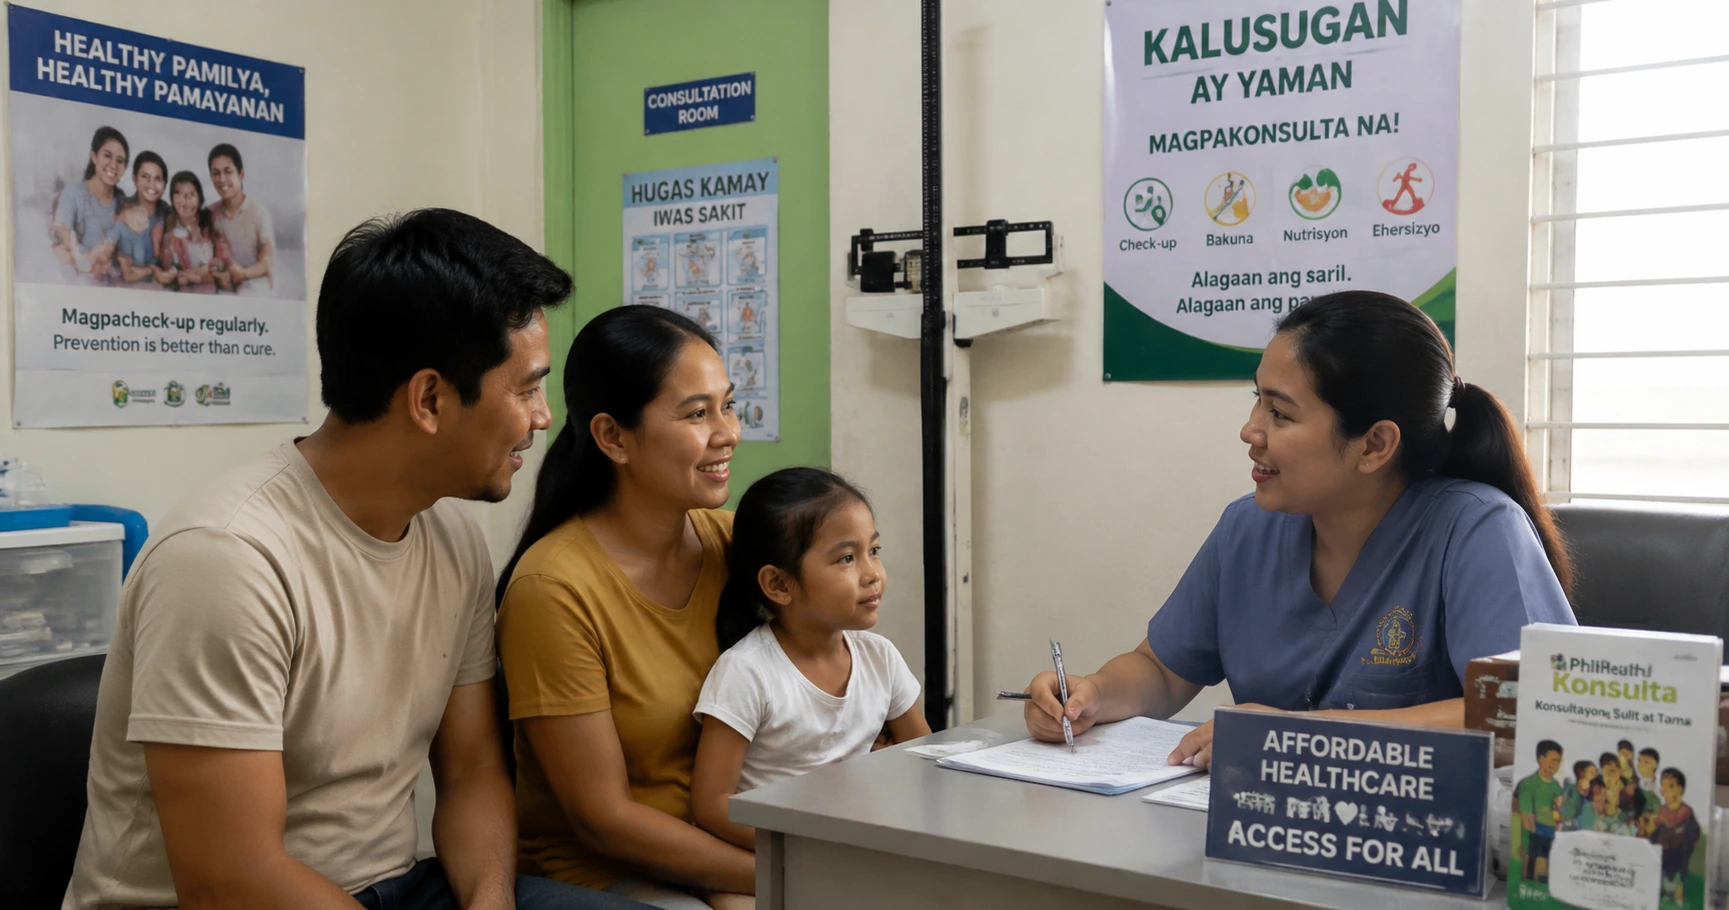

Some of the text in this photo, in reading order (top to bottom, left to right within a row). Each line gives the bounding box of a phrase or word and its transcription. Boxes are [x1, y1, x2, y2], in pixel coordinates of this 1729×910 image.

[1144, 0, 1407, 66] KALUSUGAN
[55, 30, 269, 97] HEALTHY PAMILYA,
[38, 57, 283, 123] HEALTHY PAMAYANAN
[648, 80, 751, 108] CONSULTATION
[1191, 60, 1352, 104] AY YAMAN
[679, 105, 718, 123] ROOM
[1150, 113, 1399, 154] MAGPAKONSULTA NA!
[632, 172, 769, 203] HUGAS KAMAY
[654, 203, 746, 226] IWAS SAKIT
[1207, 234, 1253, 246] Bakuna
[1284, 228, 1347, 242] Nutrisyon
[1373, 222, 1440, 237] Ehersizyo
[1120, 237, 1177, 251] Check-up
[1192, 265, 1351, 290] Alagaan ang saril.
[1177, 297, 1245, 317] Alagaan
[1251, 298, 1282, 313] ang
[63, 308, 268, 336] Magpacheck-up regularly.
[54, 334, 275, 355] Prevention is better than cure.
[1553, 672, 1677, 703] Konsulta
[1263, 730, 1433, 768] AFFORDABLE
[1261, 760, 1433, 799] HEALTHCARE
[1228, 820, 1463, 875] ACCESS FOR ALL
